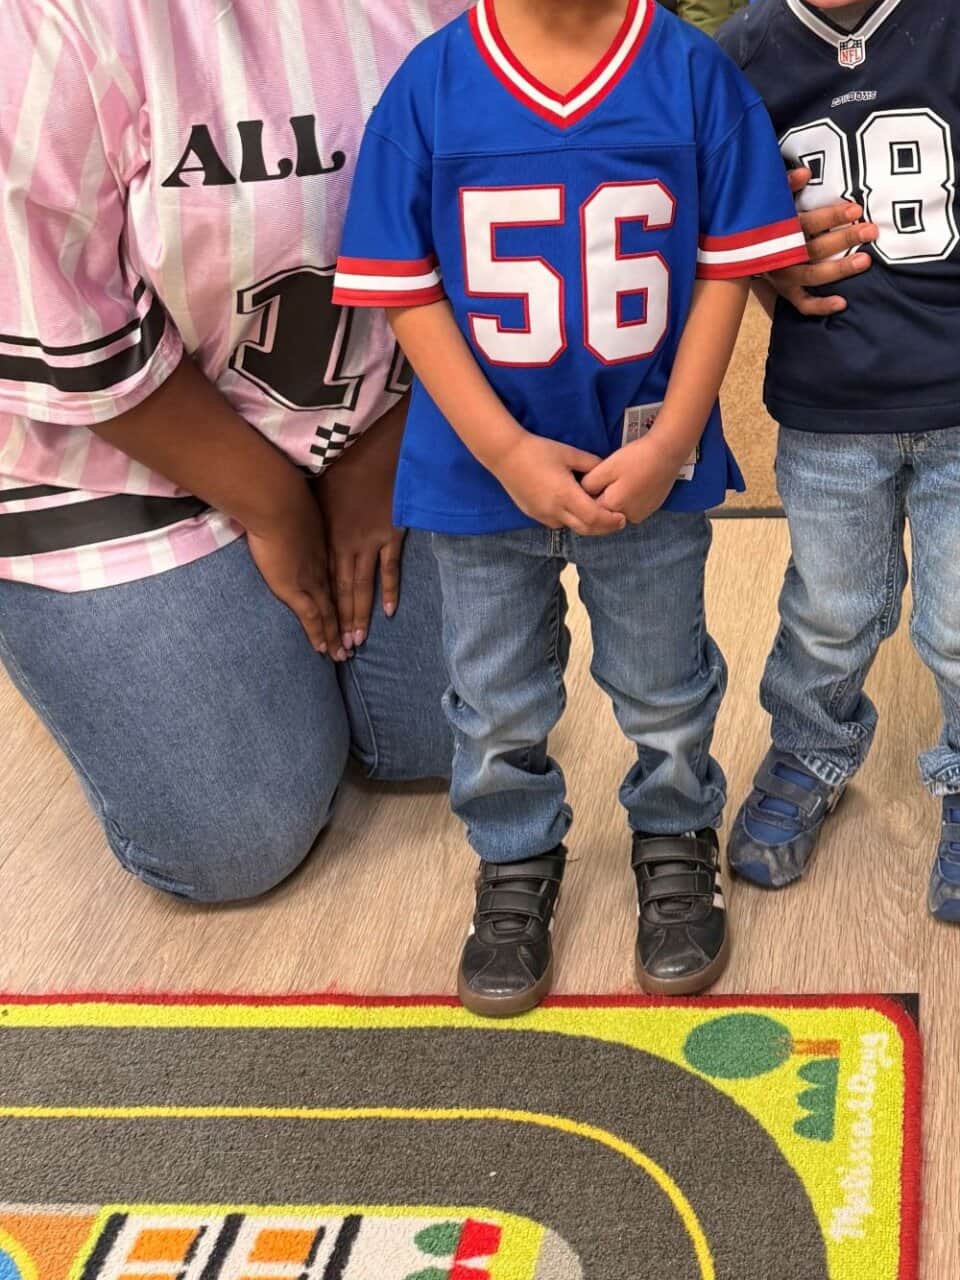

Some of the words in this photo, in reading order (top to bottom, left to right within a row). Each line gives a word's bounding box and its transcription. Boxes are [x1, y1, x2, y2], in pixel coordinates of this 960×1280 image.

[842, 48, 861, 63] NFL
[161, 114, 346, 188] ALL
[458, 178, 677, 368] 56
